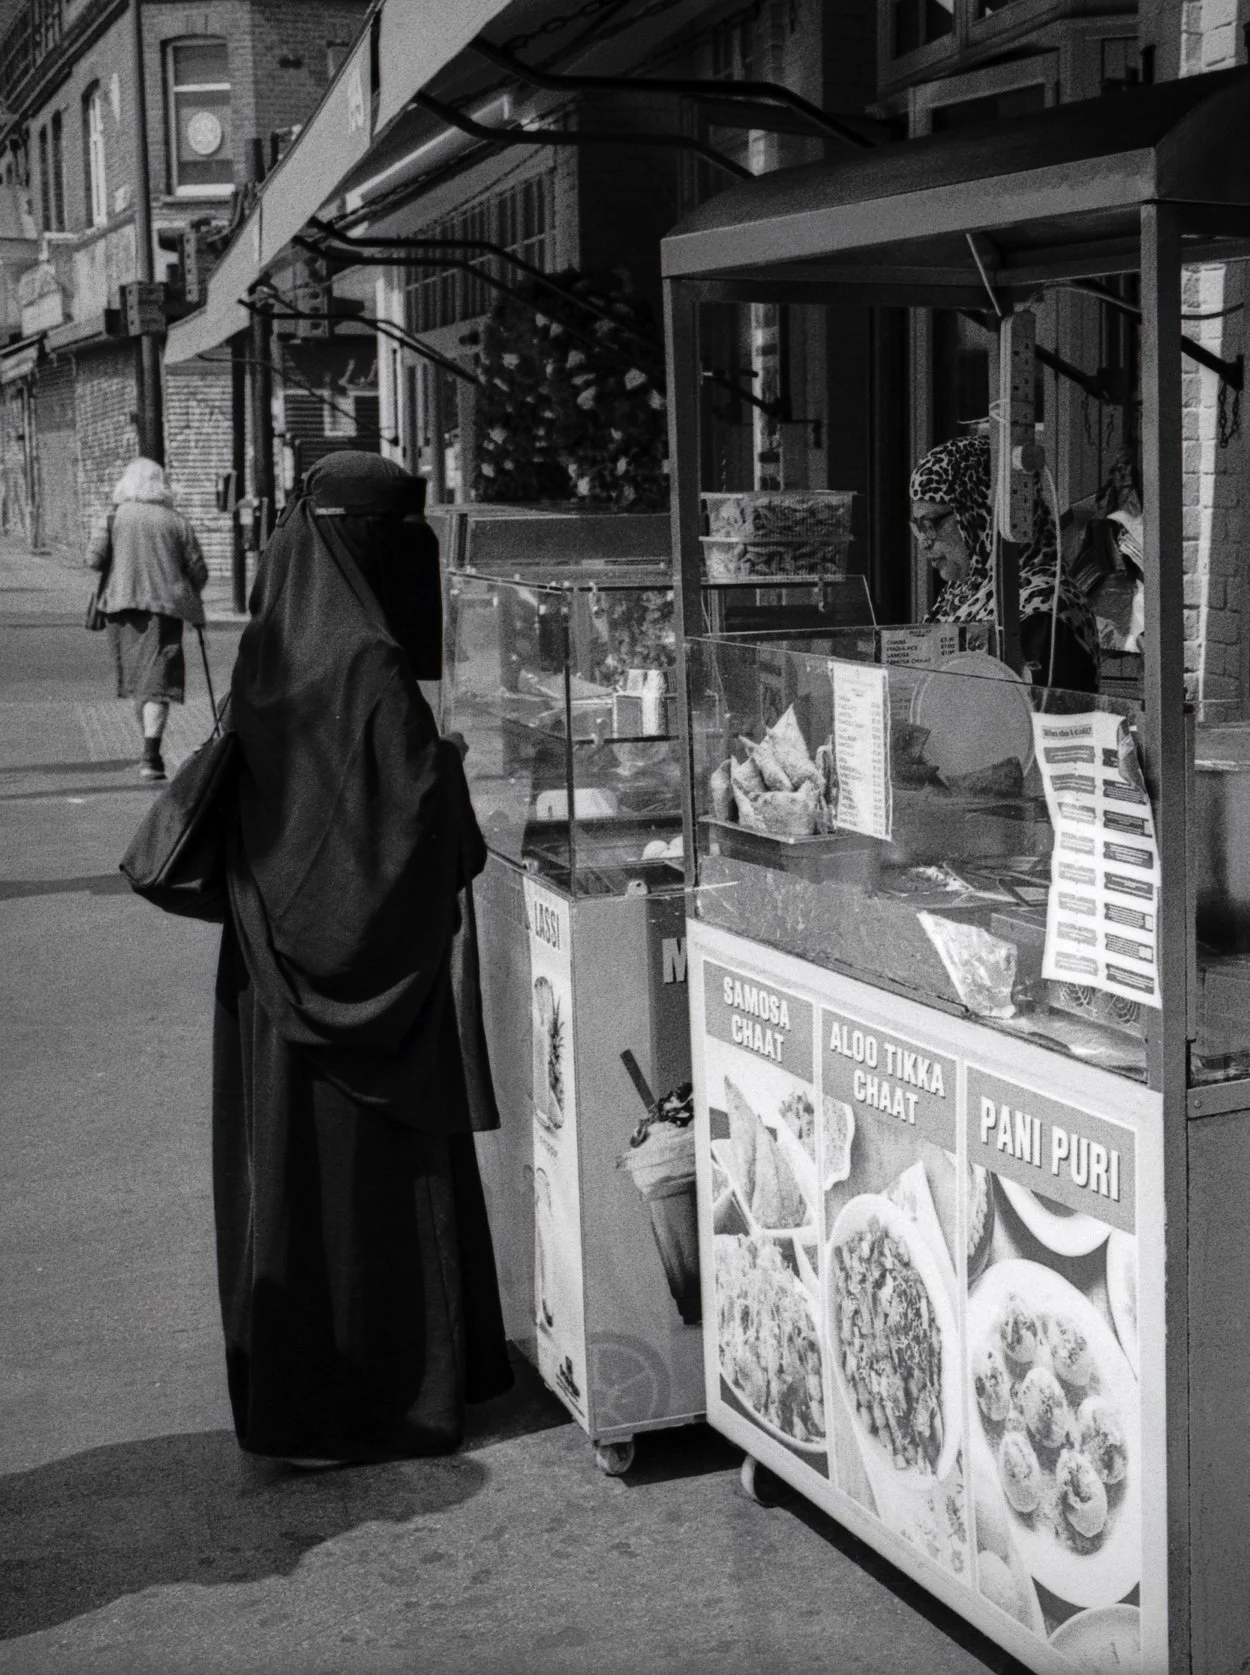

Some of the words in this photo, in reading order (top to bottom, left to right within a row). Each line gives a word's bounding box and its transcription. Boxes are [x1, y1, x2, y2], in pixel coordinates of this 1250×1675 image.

[534, 901, 560, 950] LASSI
[724, 976, 791, 1032] SAMOSA
[731, 1014, 785, 1063] CHAAT
[830, 1022, 878, 1069] ALOO
[884, 1042, 946, 1099] TIKKA
[853, 1070, 919, 1126] CHAAT
[980, 1095, 1042, 1168] PANI
[1052, 1125, 1120, 1203] PURI
